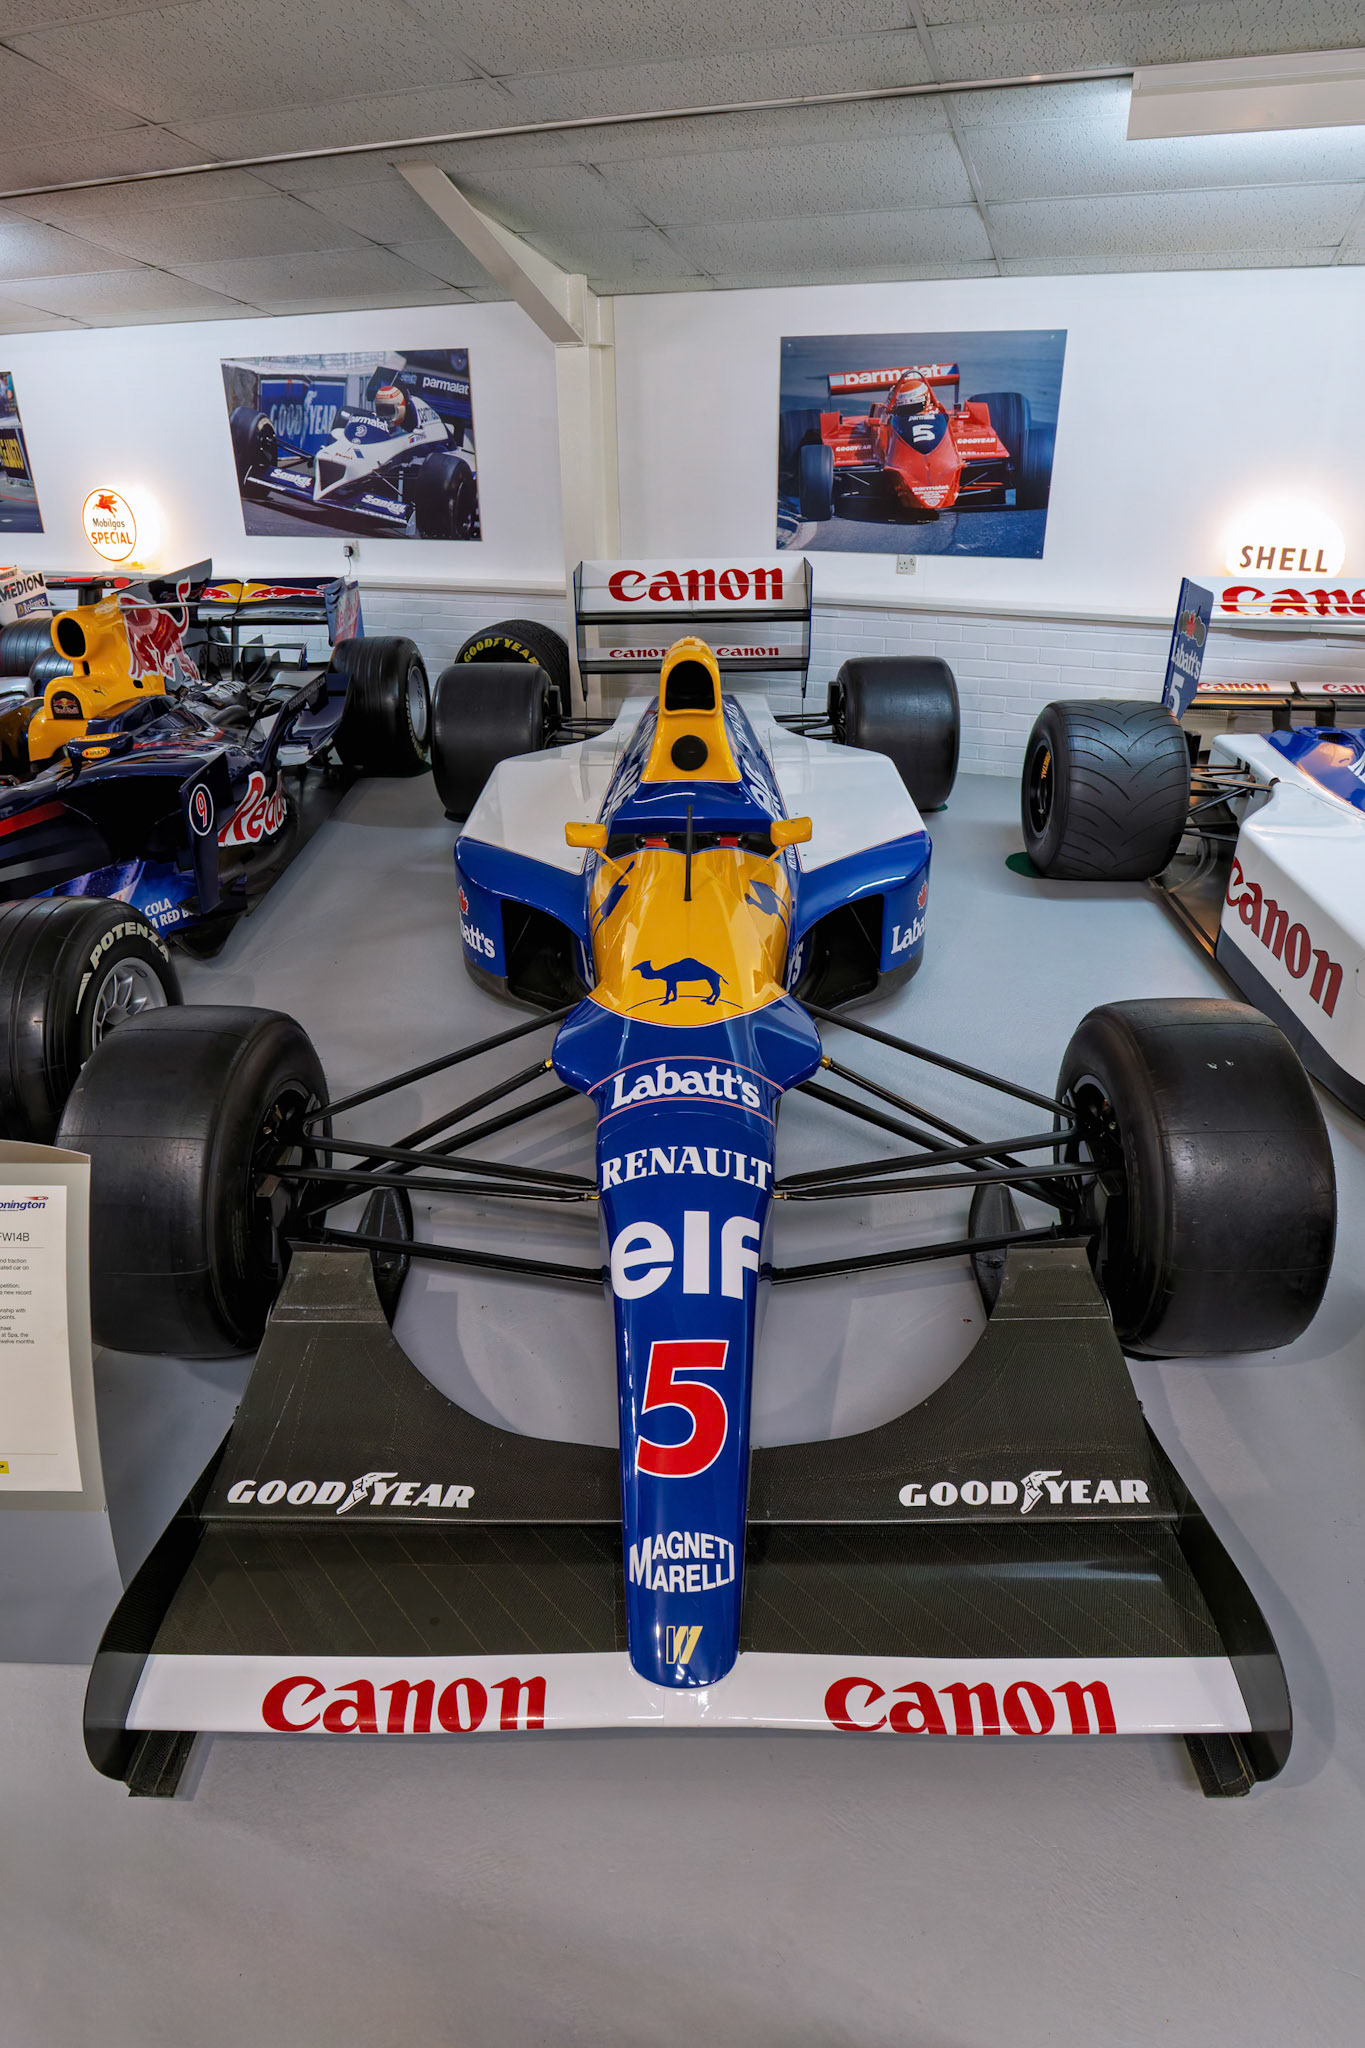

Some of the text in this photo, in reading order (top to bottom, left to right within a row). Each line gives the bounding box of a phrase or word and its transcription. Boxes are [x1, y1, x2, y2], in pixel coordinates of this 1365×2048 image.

[422, 376, 470, 396] parmalat
[844, 364, 941, 385] parmalat
[912, 424, 935, 443] 5
[91, 532, 133, 545] SPECIAL
[92, 518, 126, 531] Mobilgas
[1239, 545, 1329, 573] SHELL
[608, 567, 784, 602] Canon
[609, 648, 667, 658] Cano
[716, 647, 780, 657] Canon
[1171, 636, 1201, 681] Labatt's
[1197, 682, 1271, 692] Canon
[196, 791, 208, 828] 9
[144, 898, 172, 917] COLA
[159, 909, 181, 927] RED
[90, 921, 169, 970] POTENZA
[1226, 856, 1344, 1018] Canon
[611, 1063, 761, 1110] Labatt's
[601, 1146, 773, 1192] RENAULT
[611, 1210, 761, 1301] elf
[636, 1340, 730, 1479] 5
[261, 1675, 547, 1734] Canon
[824, 1676, 1118, 1736] Canon
